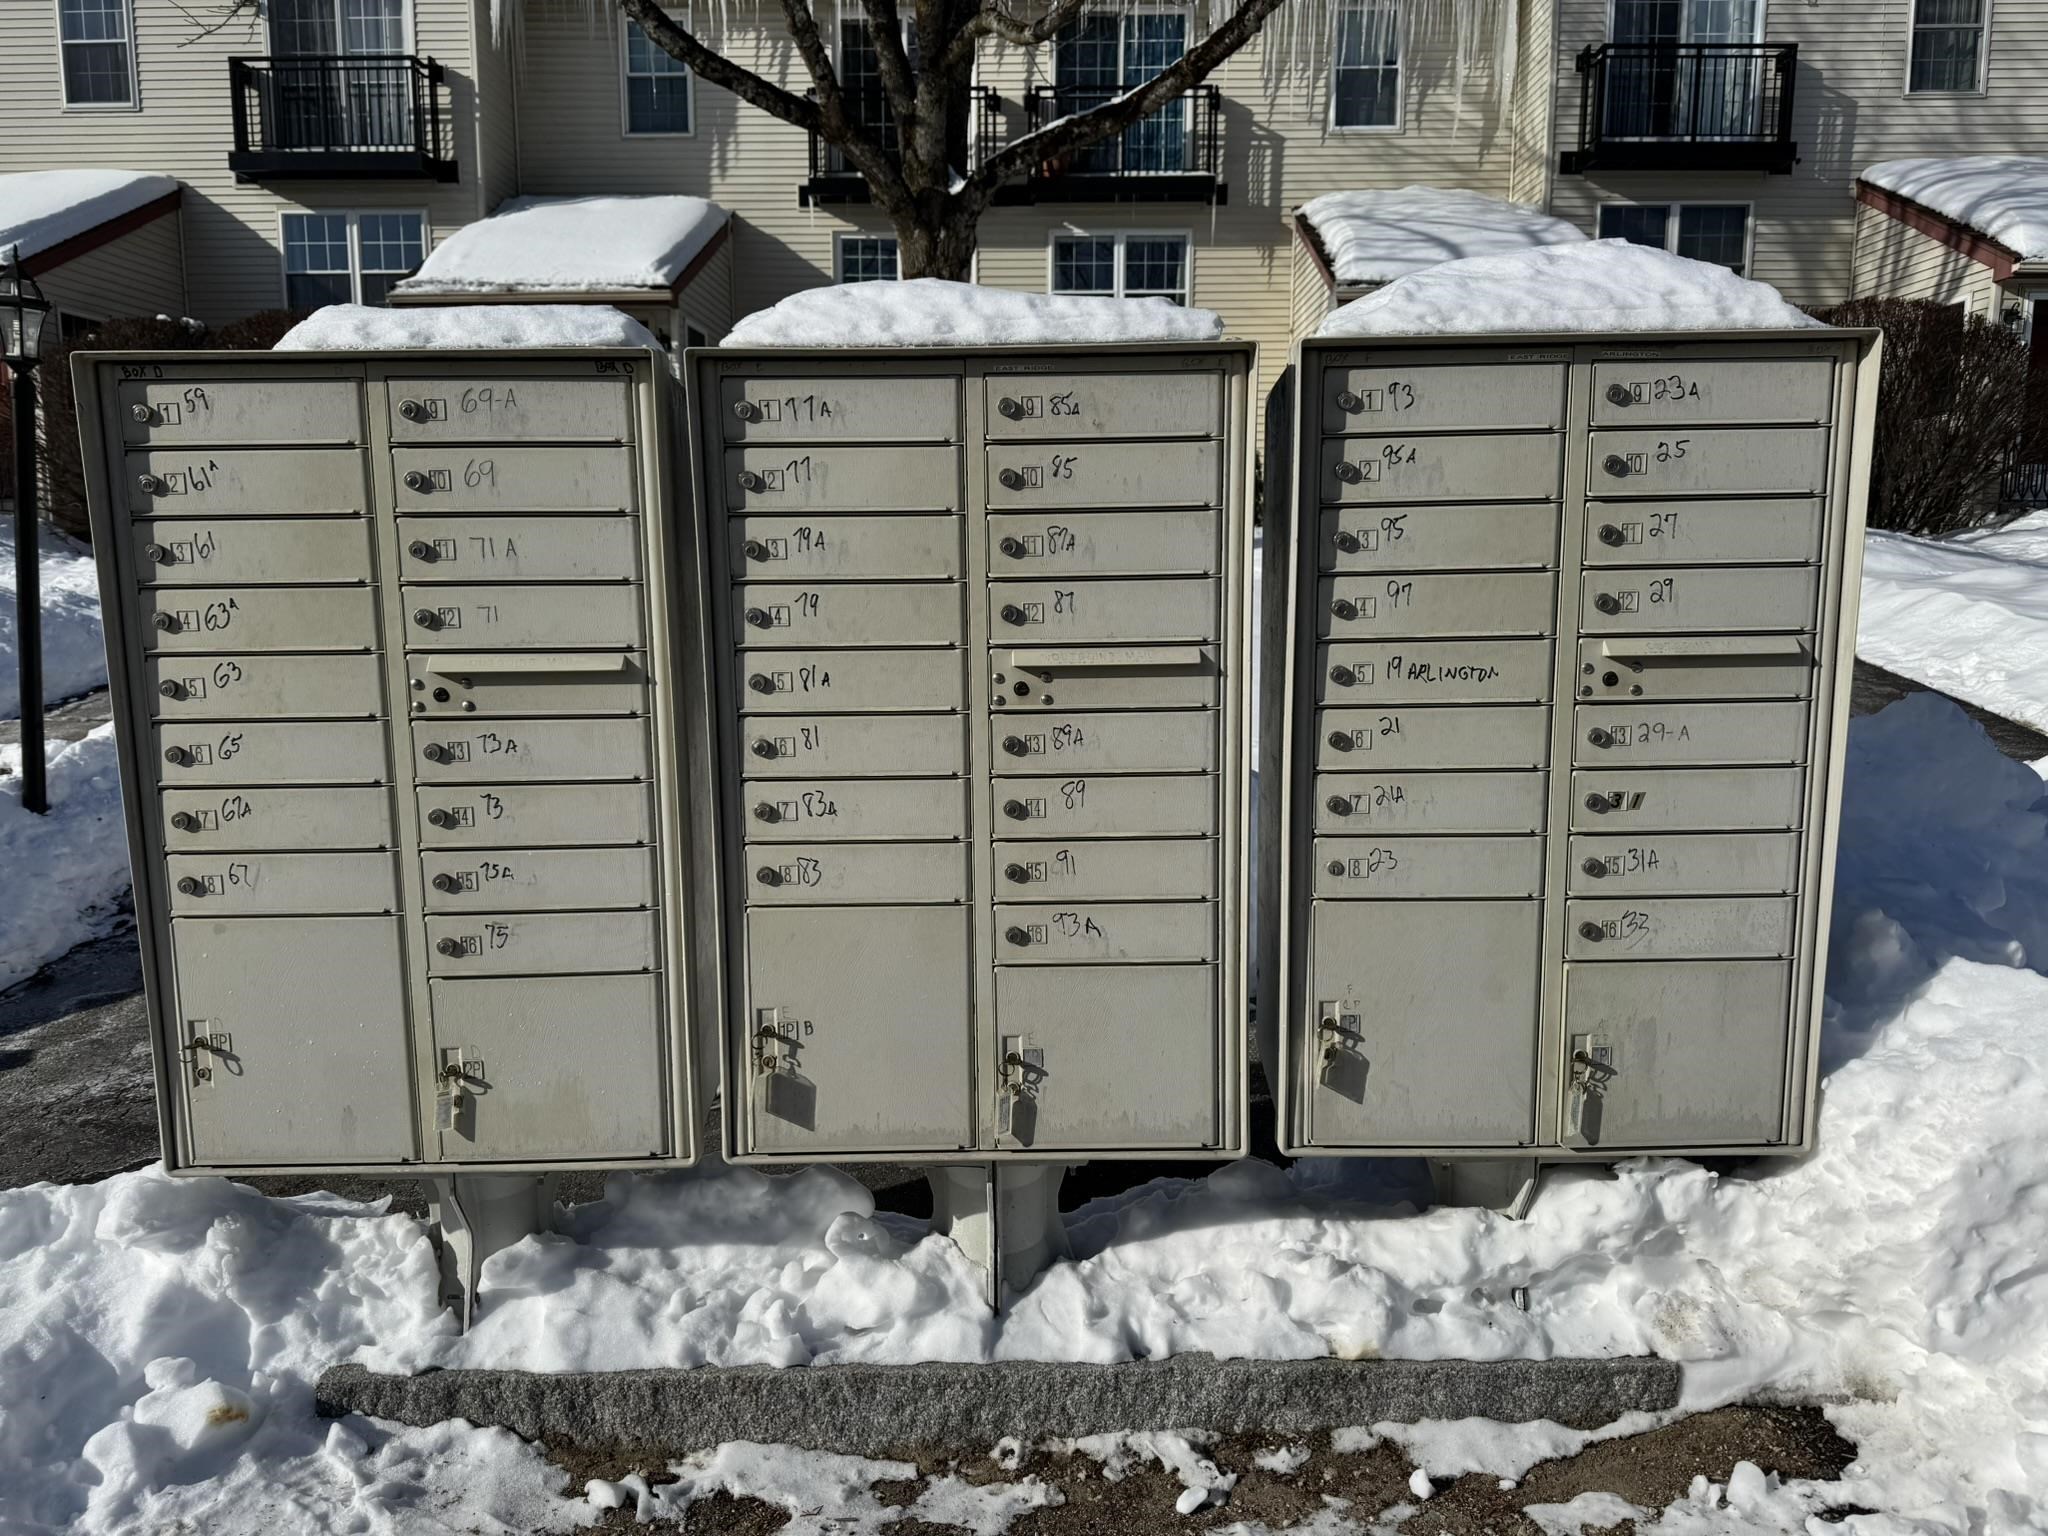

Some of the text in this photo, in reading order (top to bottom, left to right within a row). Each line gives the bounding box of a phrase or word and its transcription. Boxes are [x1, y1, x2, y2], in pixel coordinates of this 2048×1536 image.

[153, 365, 163, 378] D
[622, 361, 634, 374] D
[1633, 385, 1642, 402] 9
[1654, 375, 1700, 400] 23A
[184, 387, 209, 413] 59
[1050, 391, 1080, 416] 85A
[1389, 382, 1414, 411] 93
[428, 401, 439, 419] 9
[1025, 400, 1035, 415] 9
[1383, 445, 1416, 469] 95A
[1656, 439, 1690, 462] 25
[1052, 455, 1077, 479] 85
[1363, 463, 1372, 480] 2
[1627, 455, 1643, 473] 10
[188, 460, 219, 491] 61A
[431, 471, 447, 490] 10
[464, 459, 495, 487] 69
[766, 472, 777, 490] 2
[1023, 470, 1038, 486] 10
[169, 476, 179, 492] 2
[1381, 514, 1408, 541] 95
[1624, 525, 1637, 543] 11
[1649, 513, 1678, 539] 27
[194, 531, 215, 559] 61
[1024, 539, 1038, 554] 11
[1360, 532, 1370, 549] 3
[176, 545, 185, 561] 3
[436, 541, 450, 558] 11
[770, 541, 780, 558] 3
[1387, 580, 1412, 608] 97
[1649, 577, 1673, 603] 29
[1359, 600, 1367, 616] 4
[1620, 593, 1634, 611] 12
[182, 613, 191, 629] 4
[205, 598, 239, 631] 63A
[440, 610, 456, 626] 12
[477, 606, 497, 623] 71
[773, 608, 783, 625] 4
[1025, 605, 1039, 621] 12
[214, 662, 241, 688] 63
[799, 664, 830, 692] 81A
[1357, 666, 1366, 682] 5
[1387, 656, 1499, 684] 19 ARLINGTON
[188, 680, 198, 696] 5
[776, 675, 785, 690] 5
[1379, 717, 1400, 735] 21
[801, 725, 819, 750] 81
[1053, 724, 1083, 750] 89A
[1354, 731, 1364, 747] 6
[1611, 727, 1627, 743] 13
[218, 734, 243, 759] 65
[449, 744, 464, 759] 13
[778, 740, 788, 755] 6
[1026, 737, 1041, 752] 13
[195, 747, 204, 762] 6
[1061, 780, 1085, 809] 89
[1374, 785, 1405, 806] 21A
[1610, 793, 1640, 808] 31
[222, 796, 251, 821] 67A
[480, 794, 503, 819] 73
[781, 803, 790, 819] 7
[802, 790, 838, 817] 83A
[1027, 801, 1041, 816] 14
[1353, 796, 1362, 812] 7
[200, 813, 209, 828] 7
[454, 809, 468, 824] 14
[1352, 861, 1361, 876] 8
[1369, 848, 1398, 873] 23
[1606, 857, 1621, 873] 15
[1627, 848, 1660, 872] 31A
[229, 863, 252, 887] 67
[783, 867, 792, 883] 8
[797, 857, 822, 887] 83
[1028, 864, 1042, 879] 15
[207, 877, 216, 893] 8
[458, 874, 474, 889] 15
[485, 924, 508, 949] 75
[1028, 927, 1043, 942] 16
[1603, 922, 1618, 938] 16
[462, 938, 478, 953] 16
[780, 1023, 795, 1040] 1P
[804, 1021, 814, 1036] B
